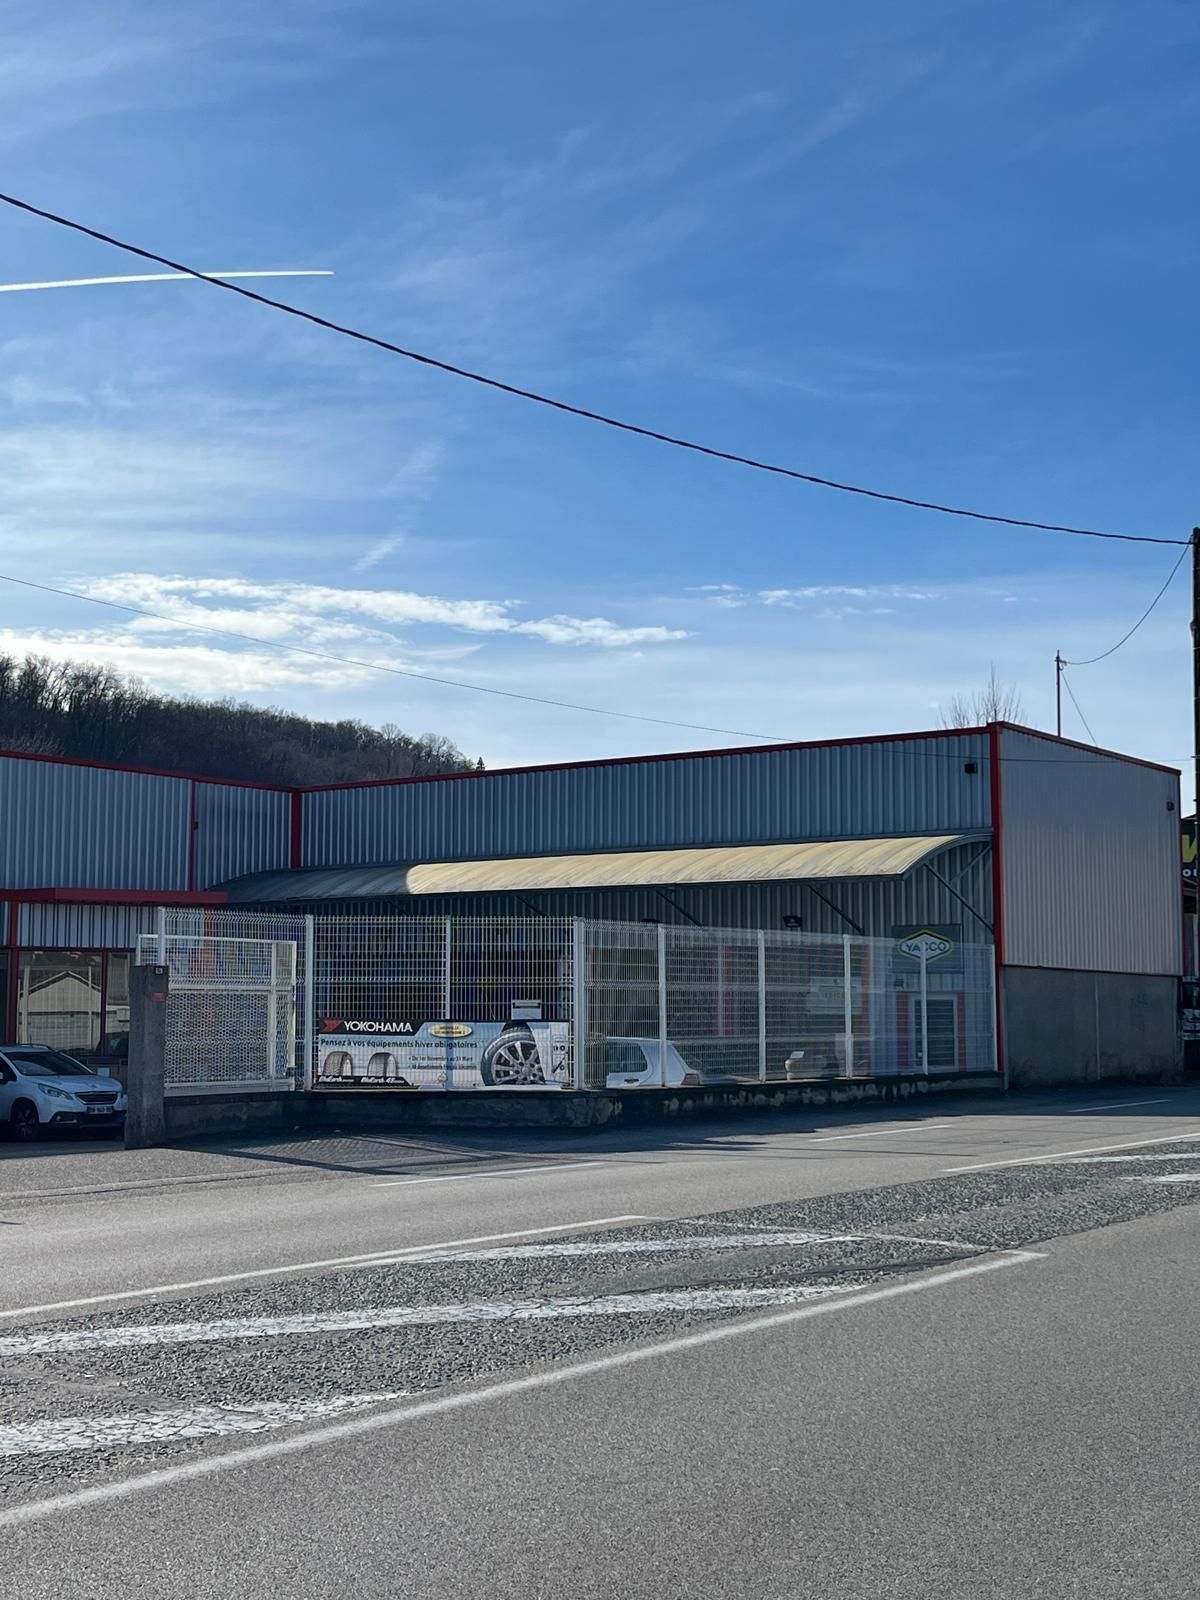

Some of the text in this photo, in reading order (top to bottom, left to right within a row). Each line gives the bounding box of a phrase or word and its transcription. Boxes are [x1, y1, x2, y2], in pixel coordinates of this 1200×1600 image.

[905, 941, 946, 952] YACO
[343, 1020, 413, 1033] YOKOHAMA
[320, 1038, 346, 1047] Pensez
[353, 1039, 366, 1048] vos
[366, 1038, 413, 1048] équipements
[415, 1039, 433, 1048] hiver
[434, 1039, 478, 1050] obligatoires
